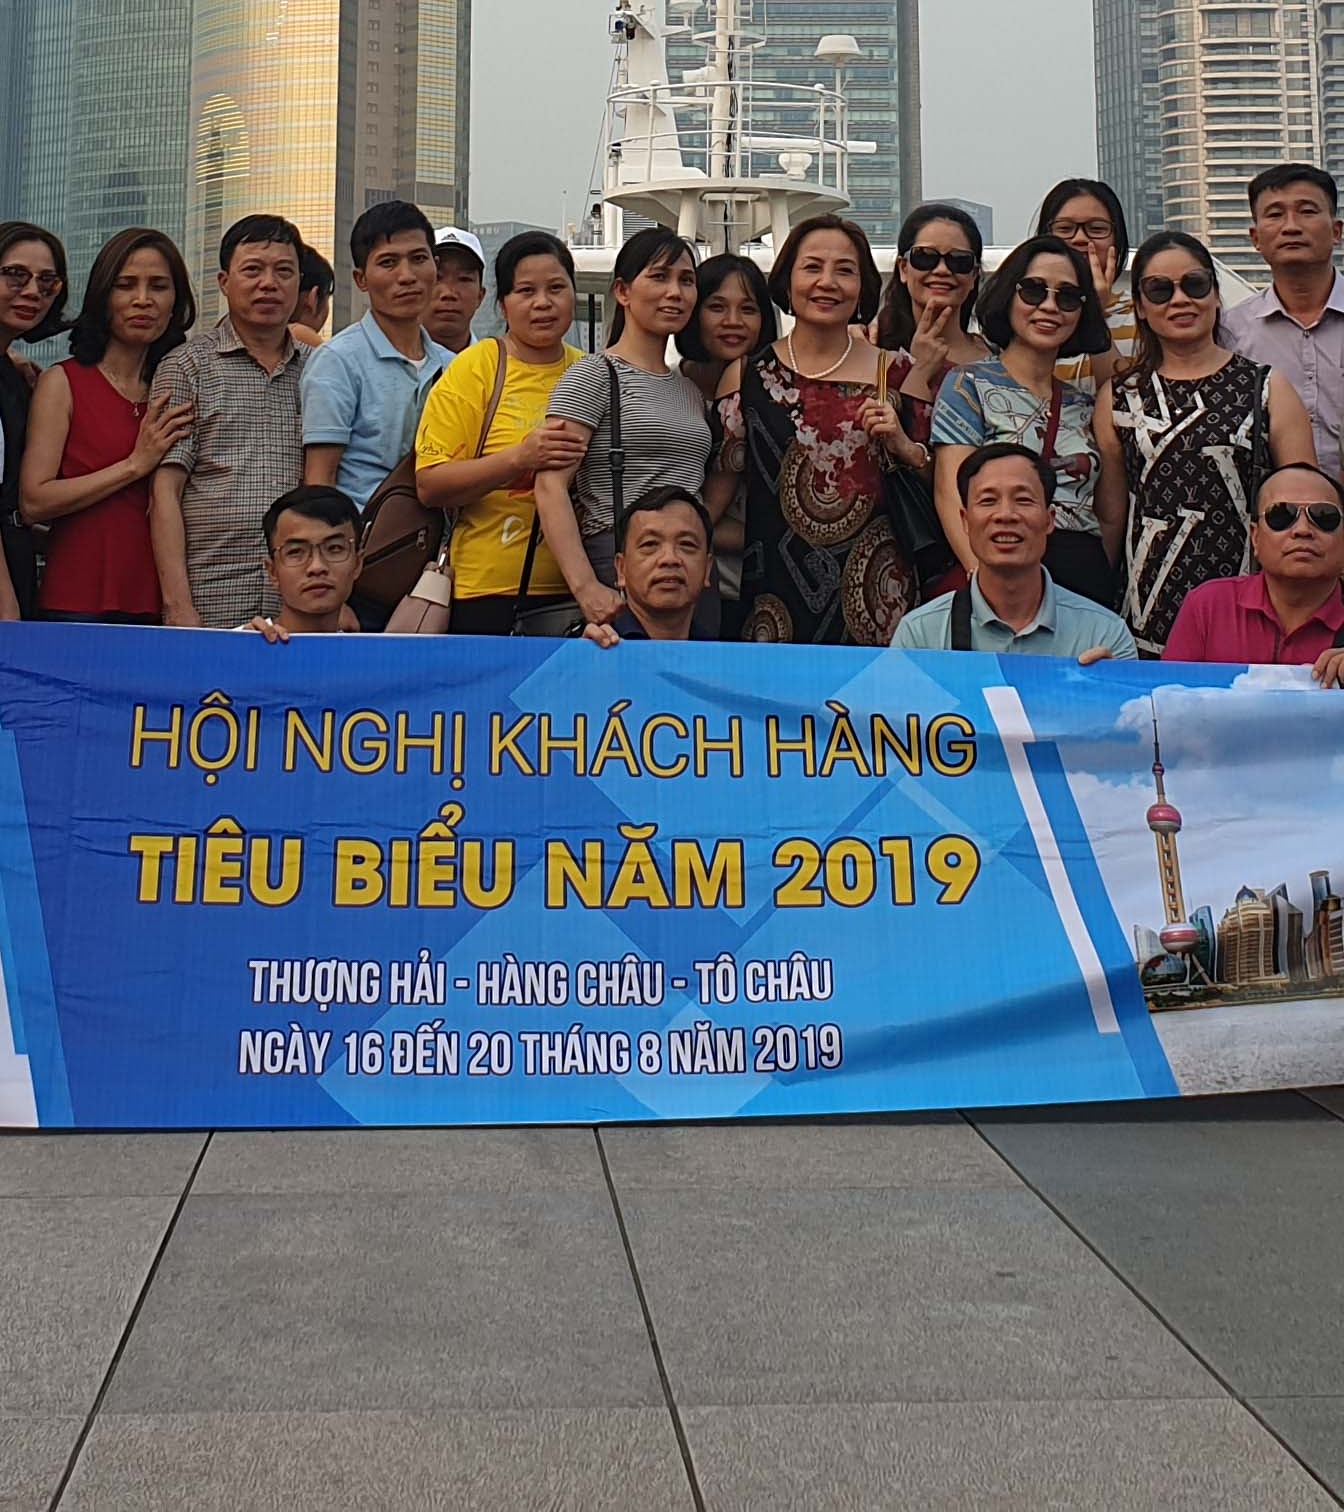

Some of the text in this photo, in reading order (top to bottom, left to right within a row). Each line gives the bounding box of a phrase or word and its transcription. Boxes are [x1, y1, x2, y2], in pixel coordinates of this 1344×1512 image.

[130, 690, 978, 791] HỘI NGHỊ KHÁCH HÀNG
[129, 801, 981, 911] TIÊU BIỂU NĂM 2019
[248, 956, 382, 1013] THƯỢNG
[388, 948, 447, 1006] HẢI
[477, 953, 569, 1006] HÀNG
[576, 953, 664, 1007] CHÂU
[694, 952, 739, 1004] TÔ
[745, 950, 834, 1002] CHÂU
[238, 1019, 843, 1076] NGÀY 16 ĐẾN 20 THÁNG 8 NĂM 2019
